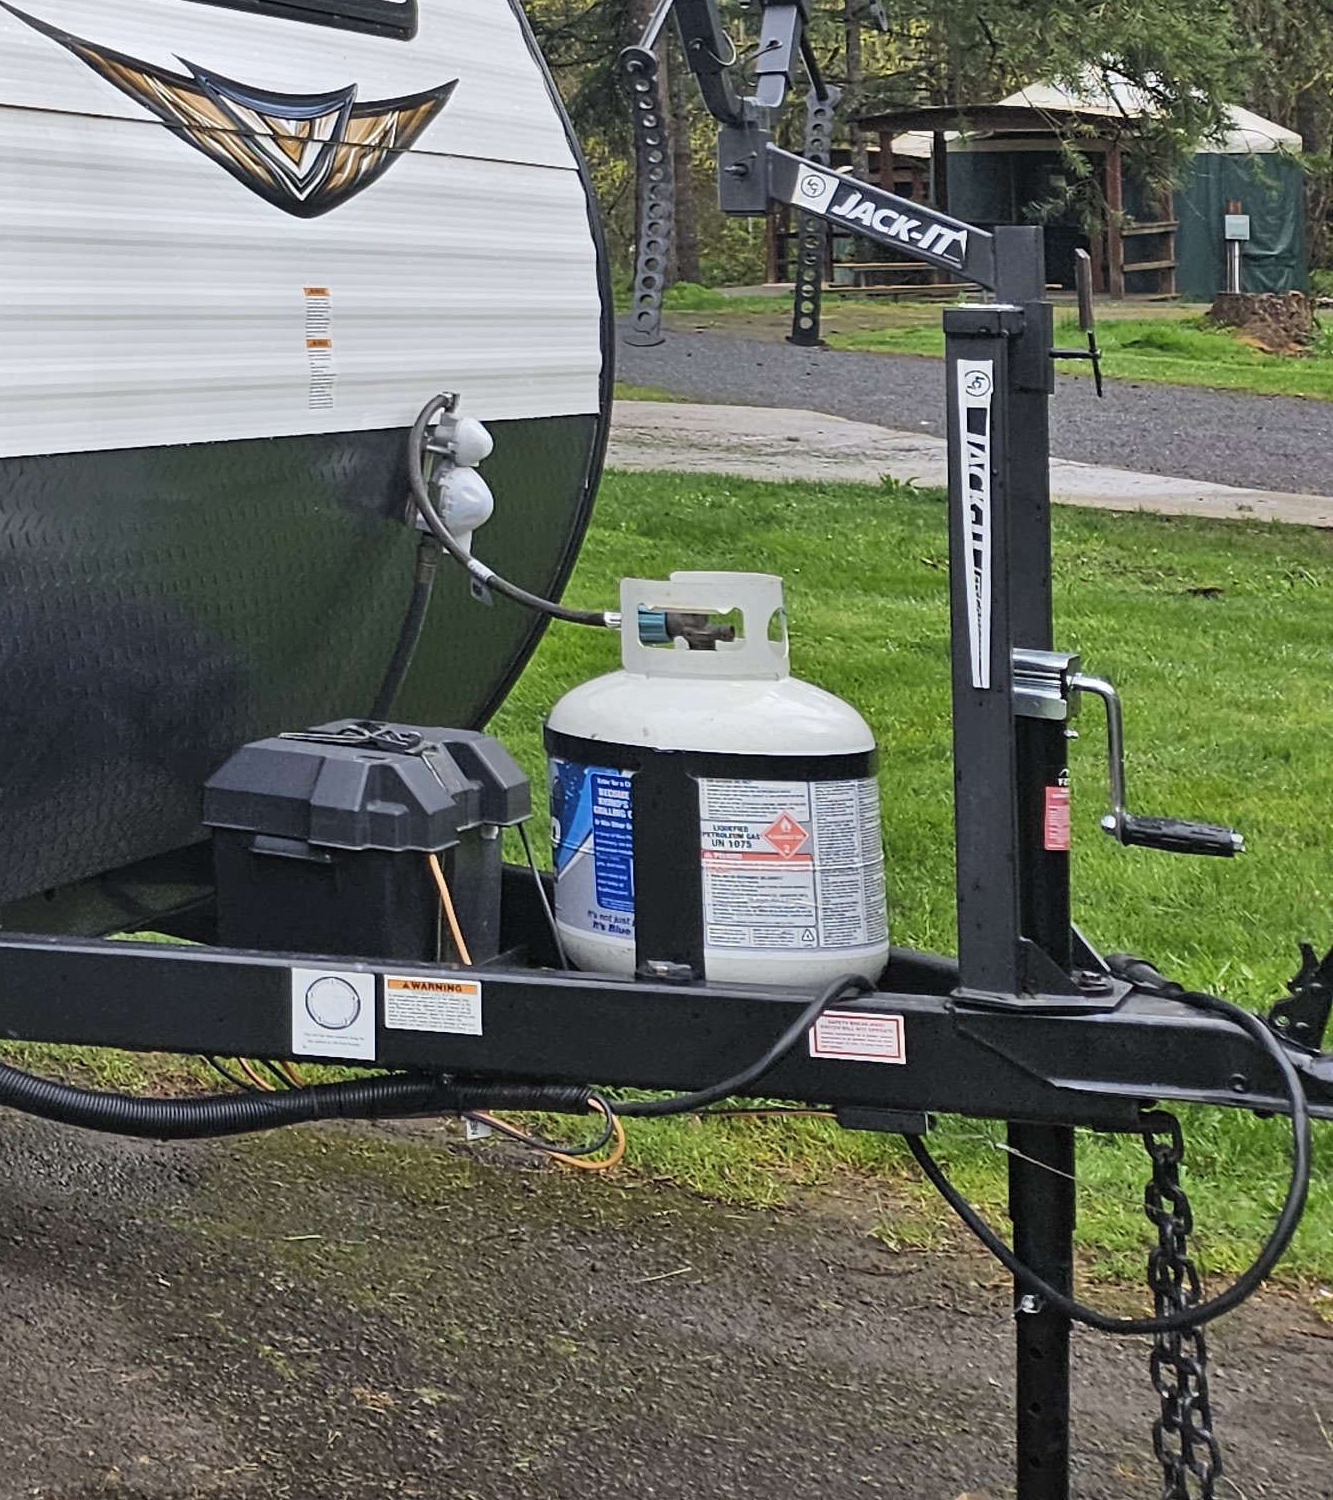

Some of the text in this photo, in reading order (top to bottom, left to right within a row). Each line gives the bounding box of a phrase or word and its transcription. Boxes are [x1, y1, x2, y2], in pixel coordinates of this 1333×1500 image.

[831, 190, 963, 256] JACK-IT
[712, 839, 752, 848] UN 1075
[783, 844, 791, 854] 2
[609, 924, 631, 935] Blue
[411, 981, 463, 993] WARNING
